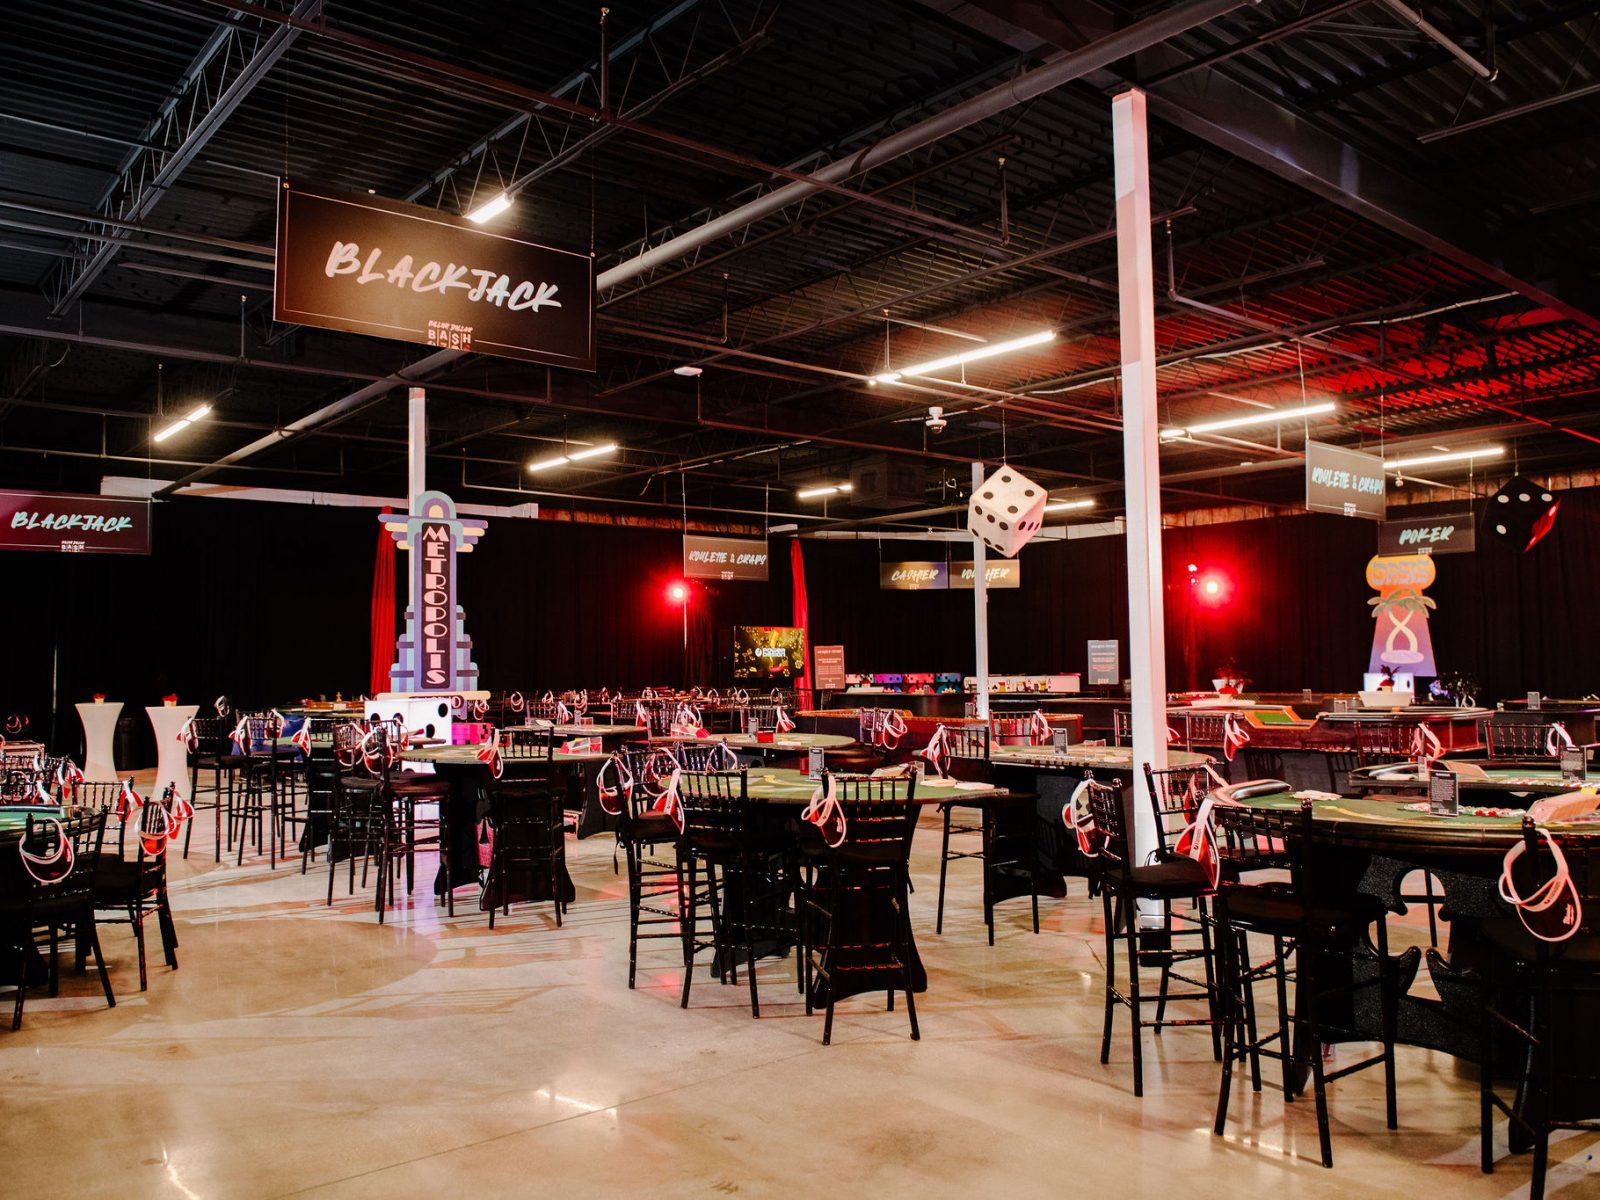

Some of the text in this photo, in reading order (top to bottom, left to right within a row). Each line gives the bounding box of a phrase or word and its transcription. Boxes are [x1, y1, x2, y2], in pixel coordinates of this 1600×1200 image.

[325, 241, 562, 313] BLACKJACK
[11, 512, 133, 533] BLACKJACK
[1398, 525, 1455, 545] POKER
[891, 569, 939, 583] CASHIER
[1371, 560, 1429, 586] OASIS
[423, 526, 450, 684] METROPOLIS
